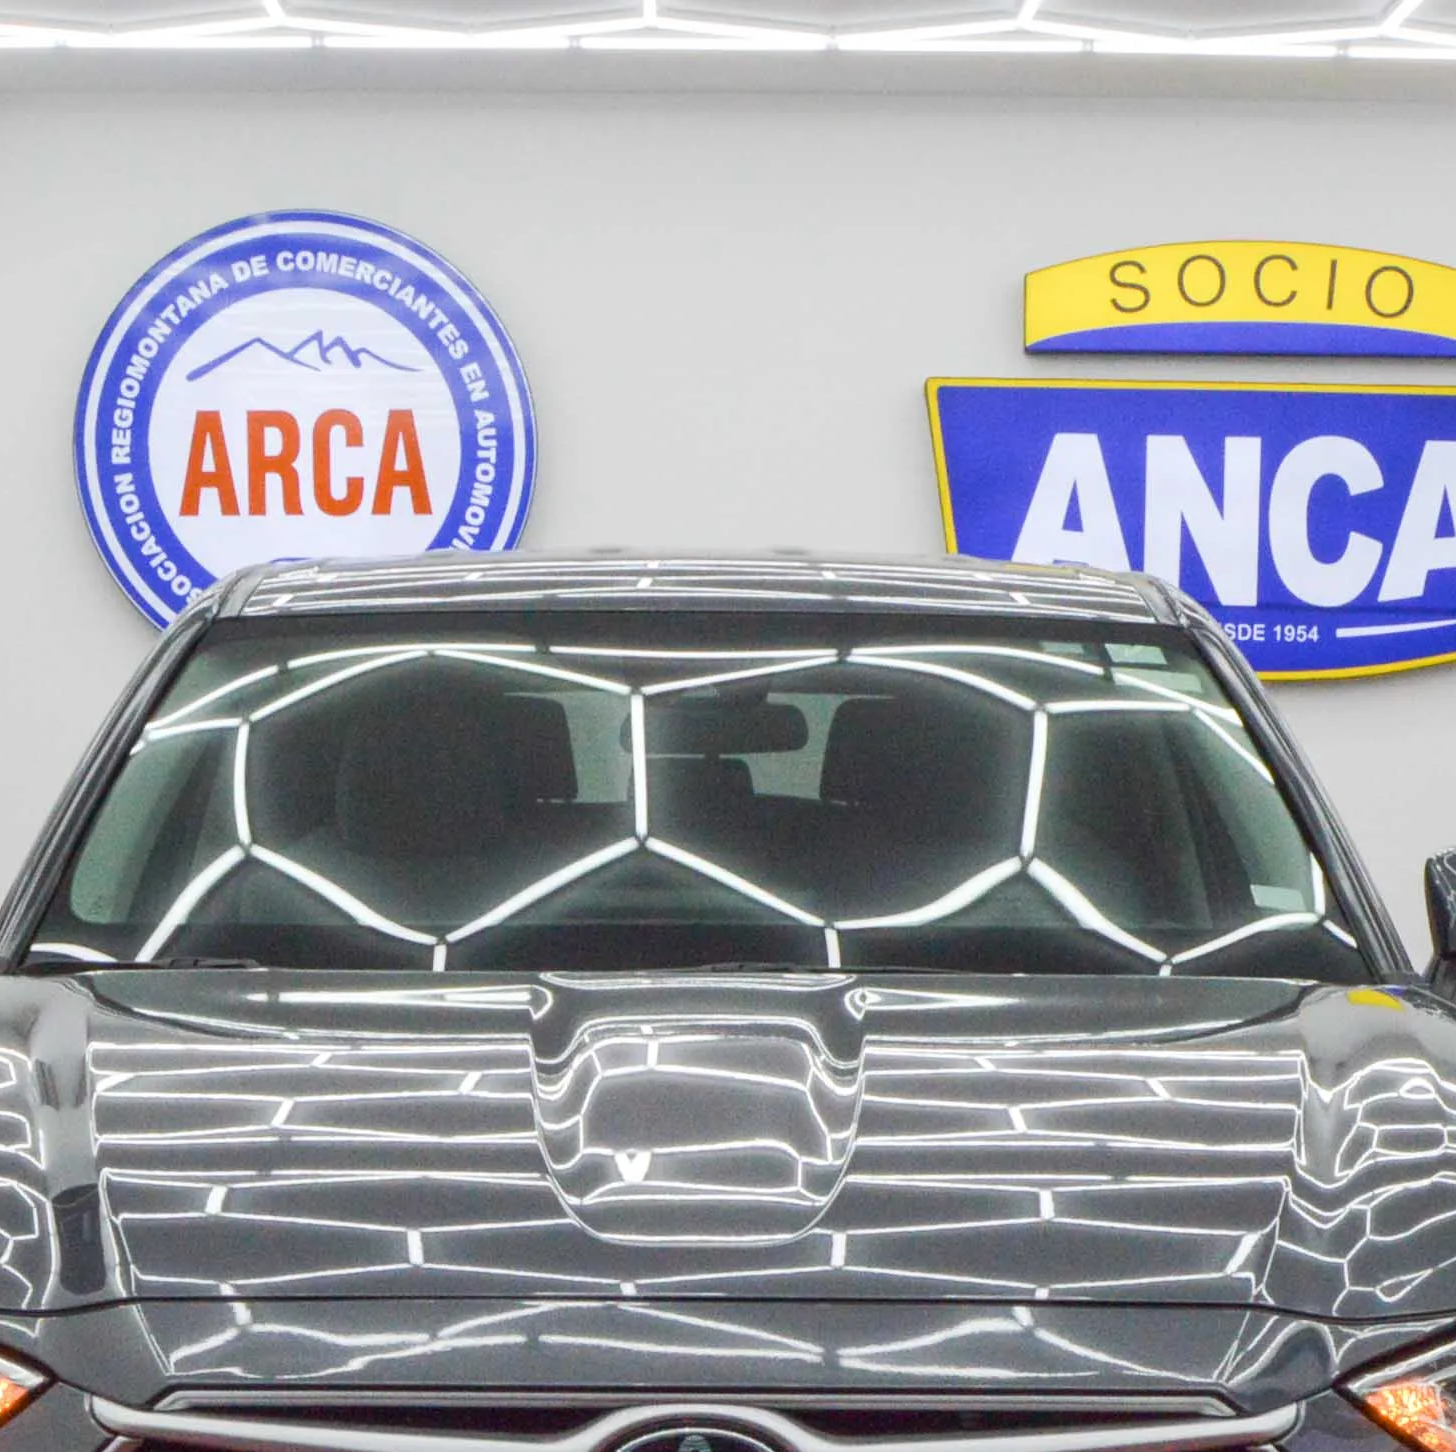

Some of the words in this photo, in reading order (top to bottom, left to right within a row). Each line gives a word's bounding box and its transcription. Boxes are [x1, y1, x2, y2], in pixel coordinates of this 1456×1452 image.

[1109, 254, 1415, 318] SOCIO
[111, 272, 229, 464] REGIOMONTANA
[231, 255, 270, 283] DE
[276, 250, 469, 360] COMERCIANTES
[460, 362, 490, 402] EN
[179, 408, 434, 517] ARCA
[1222, 622, 1266, 641] SDE
[1273, 624, 1320, 642] 1954
